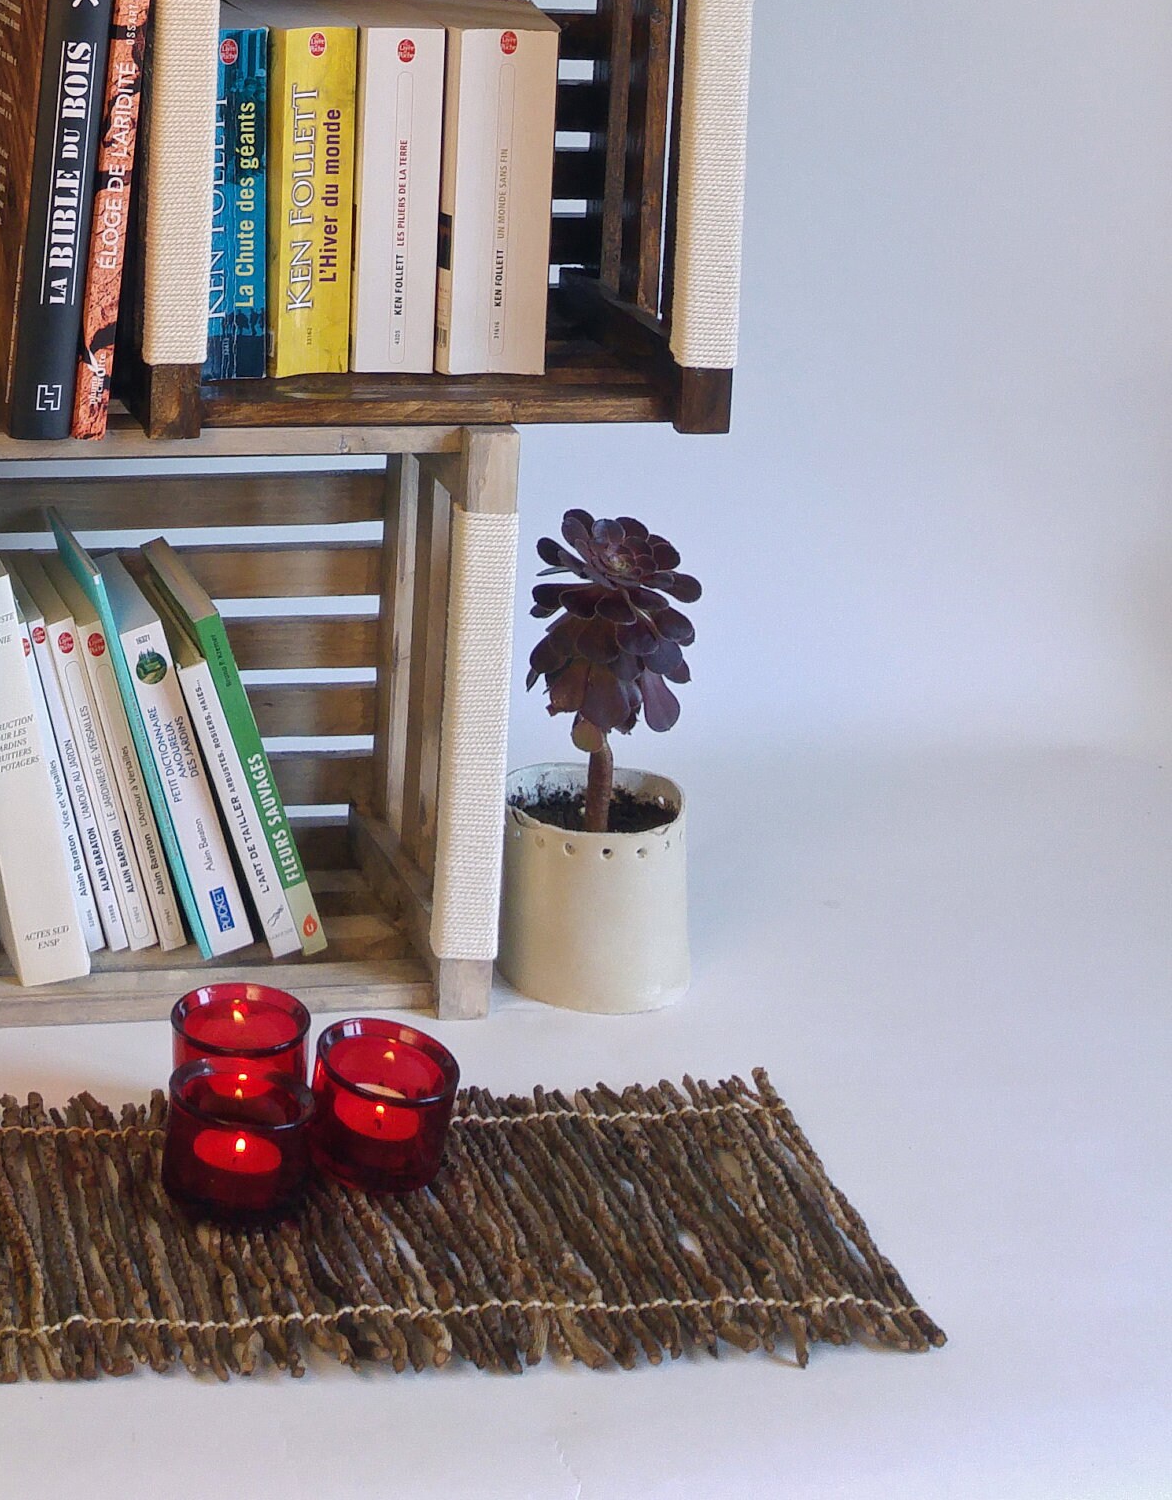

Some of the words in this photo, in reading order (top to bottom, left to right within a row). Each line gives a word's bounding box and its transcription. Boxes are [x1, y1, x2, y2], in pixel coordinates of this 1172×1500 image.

[126, 5, 139, 45] OSSART
[61, 41, 93, 120] BOIS
[110, 61, 137, 158] L'ARIDITÉ
[61, 128, 81, 160] DU
[235, 101, 260, 170] géants
[323, 108, 342, 176] monde
[289, 83, 320, 227] FOLLETT
[399, 139, 409, 167] TERRE
[500, 148, 509, 165] FIN
[106, 162, 127, 193] DE
[398, 182, 407, 195] DE
[399, 168, 408, 181] LA
[499, 165, 509, 192] SANS
[235, 175, 255, 212] des
[321, 183, 339, 209] du
[498, 192, 508, 225] MONDE
[48, 169, 81, 269] BIBLE
[397, 196, 407, 230] PILIERS
[96, 197, 123, 270] ÉLOGE
[234, 219, 255, 278] Chute
[319, 214, 338, 284] L'Hiver
[396, 231, 405, 248] LES
[497, 225, 506, 241] UN
[286, 238, 315, 312] KEN
[394, 254, 405, 294] FOLLETT
[494, 249, 505, 289] FOLLETT
[49, 276, 68, 305] LA
[235, 284, 255, 308] La
[394, 295, 403, 316] KEN
[493, 288, 503, 308] KEN
[13, 726, 28, 739] LES
[79, 705, 100, 752] VERSAILLES
[146, 705, 176, 778] DICTIONNAIRE
[174, 715, 195, 758] JARDINS
[0, 754, 41, 774] POTAGERS
[62, 739, 79, 768] JARDIN
[92, 752, 103, 767] DE
[121, 746, 136, 784] Versailles
[165, 721, 188, 779] AMOUREUX
[49, 759, 64, 799] Versailles
[71, 767, 83, 783] AU
[186, 757, 200, 778] DES
[76, 781, 92, 820] L'AMOUR
[95, 767, 115, 809] JARDINIER
[169, 779, 182, 803] PETIT
[247, 752, 283, 827] SAUVAGES
[59, 799, 68, 811] et
[61, 813, 71, 829] Vice
[106, 811, 116, 822] LE
[133, 793, 148, 828] L'Amour
[231, 796, 254, 844] TAILLER
[86, 826, 104, 866] BARATON
[111, 828, 130, 867] BARATON
[195, 817, 210, 850] Baraton
[67, 833, 82, 872] Baraton
[144, 833, 159, 871] Baraton
[201, 849, 216, 872] Alain
[246, 843, 260, 861] DE
[271, 829, 301, 882] FLEURS
[76, 873, 89, 897] Alain
[95, 864, 111, 892] ALAIN
[122, 866, 136, 893] ALAIN
[154, 871, 166, 896] Alain
[250, 861, 270, 894] L'ART
[209, 887, 235, 932] POCKET
[24, 929, 51, 941] ACTES
[52, 925, 69, 935] SUD
